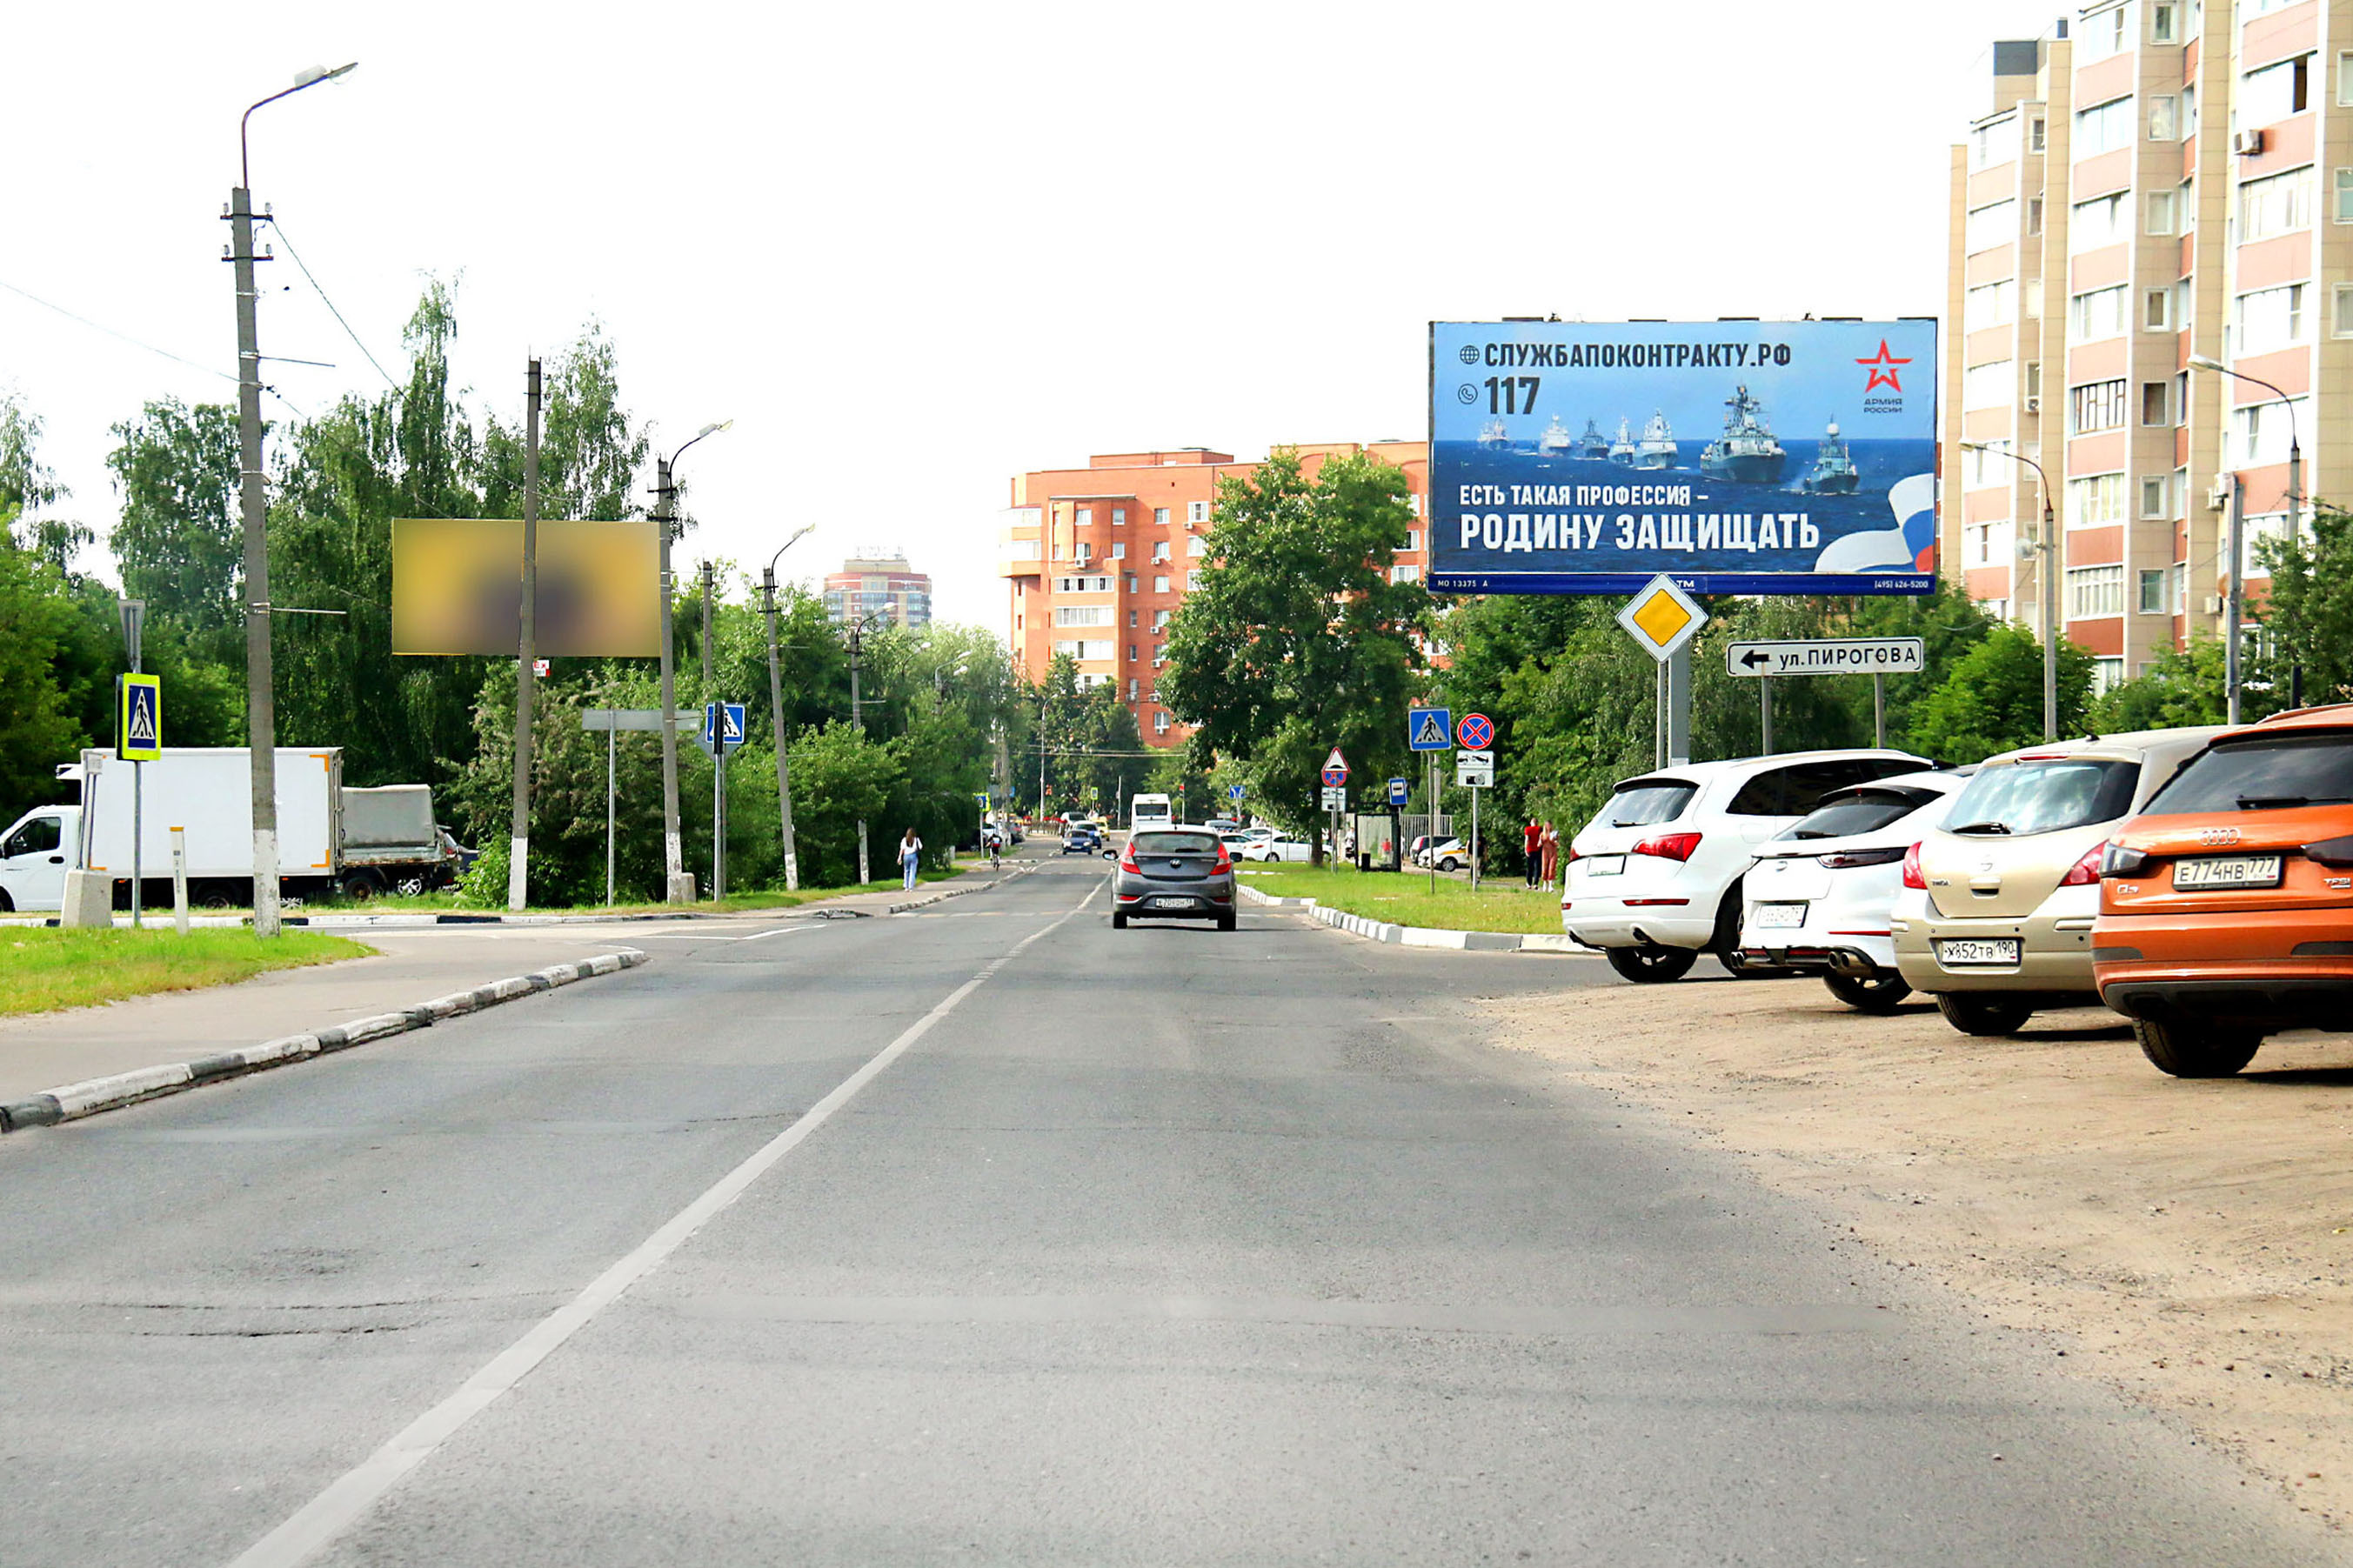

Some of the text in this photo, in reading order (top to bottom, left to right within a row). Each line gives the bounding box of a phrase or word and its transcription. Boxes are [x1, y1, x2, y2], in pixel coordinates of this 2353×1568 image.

[1484, 343, 1792, 367] СЛУЖБАПОКОНТРАКТУ.РФ
[1484, 376, 1541, 415] 117
[1460, 485, 1505, 505] ЕСТЬ
[1510, 485, 1570, 505] ТАКАЯ
[1576, 485, 1690, 506] ПРОФЕССИЯ
[1461, 514, 1820, 553] РОДИНУ ЗАЩИЩАТЬ
